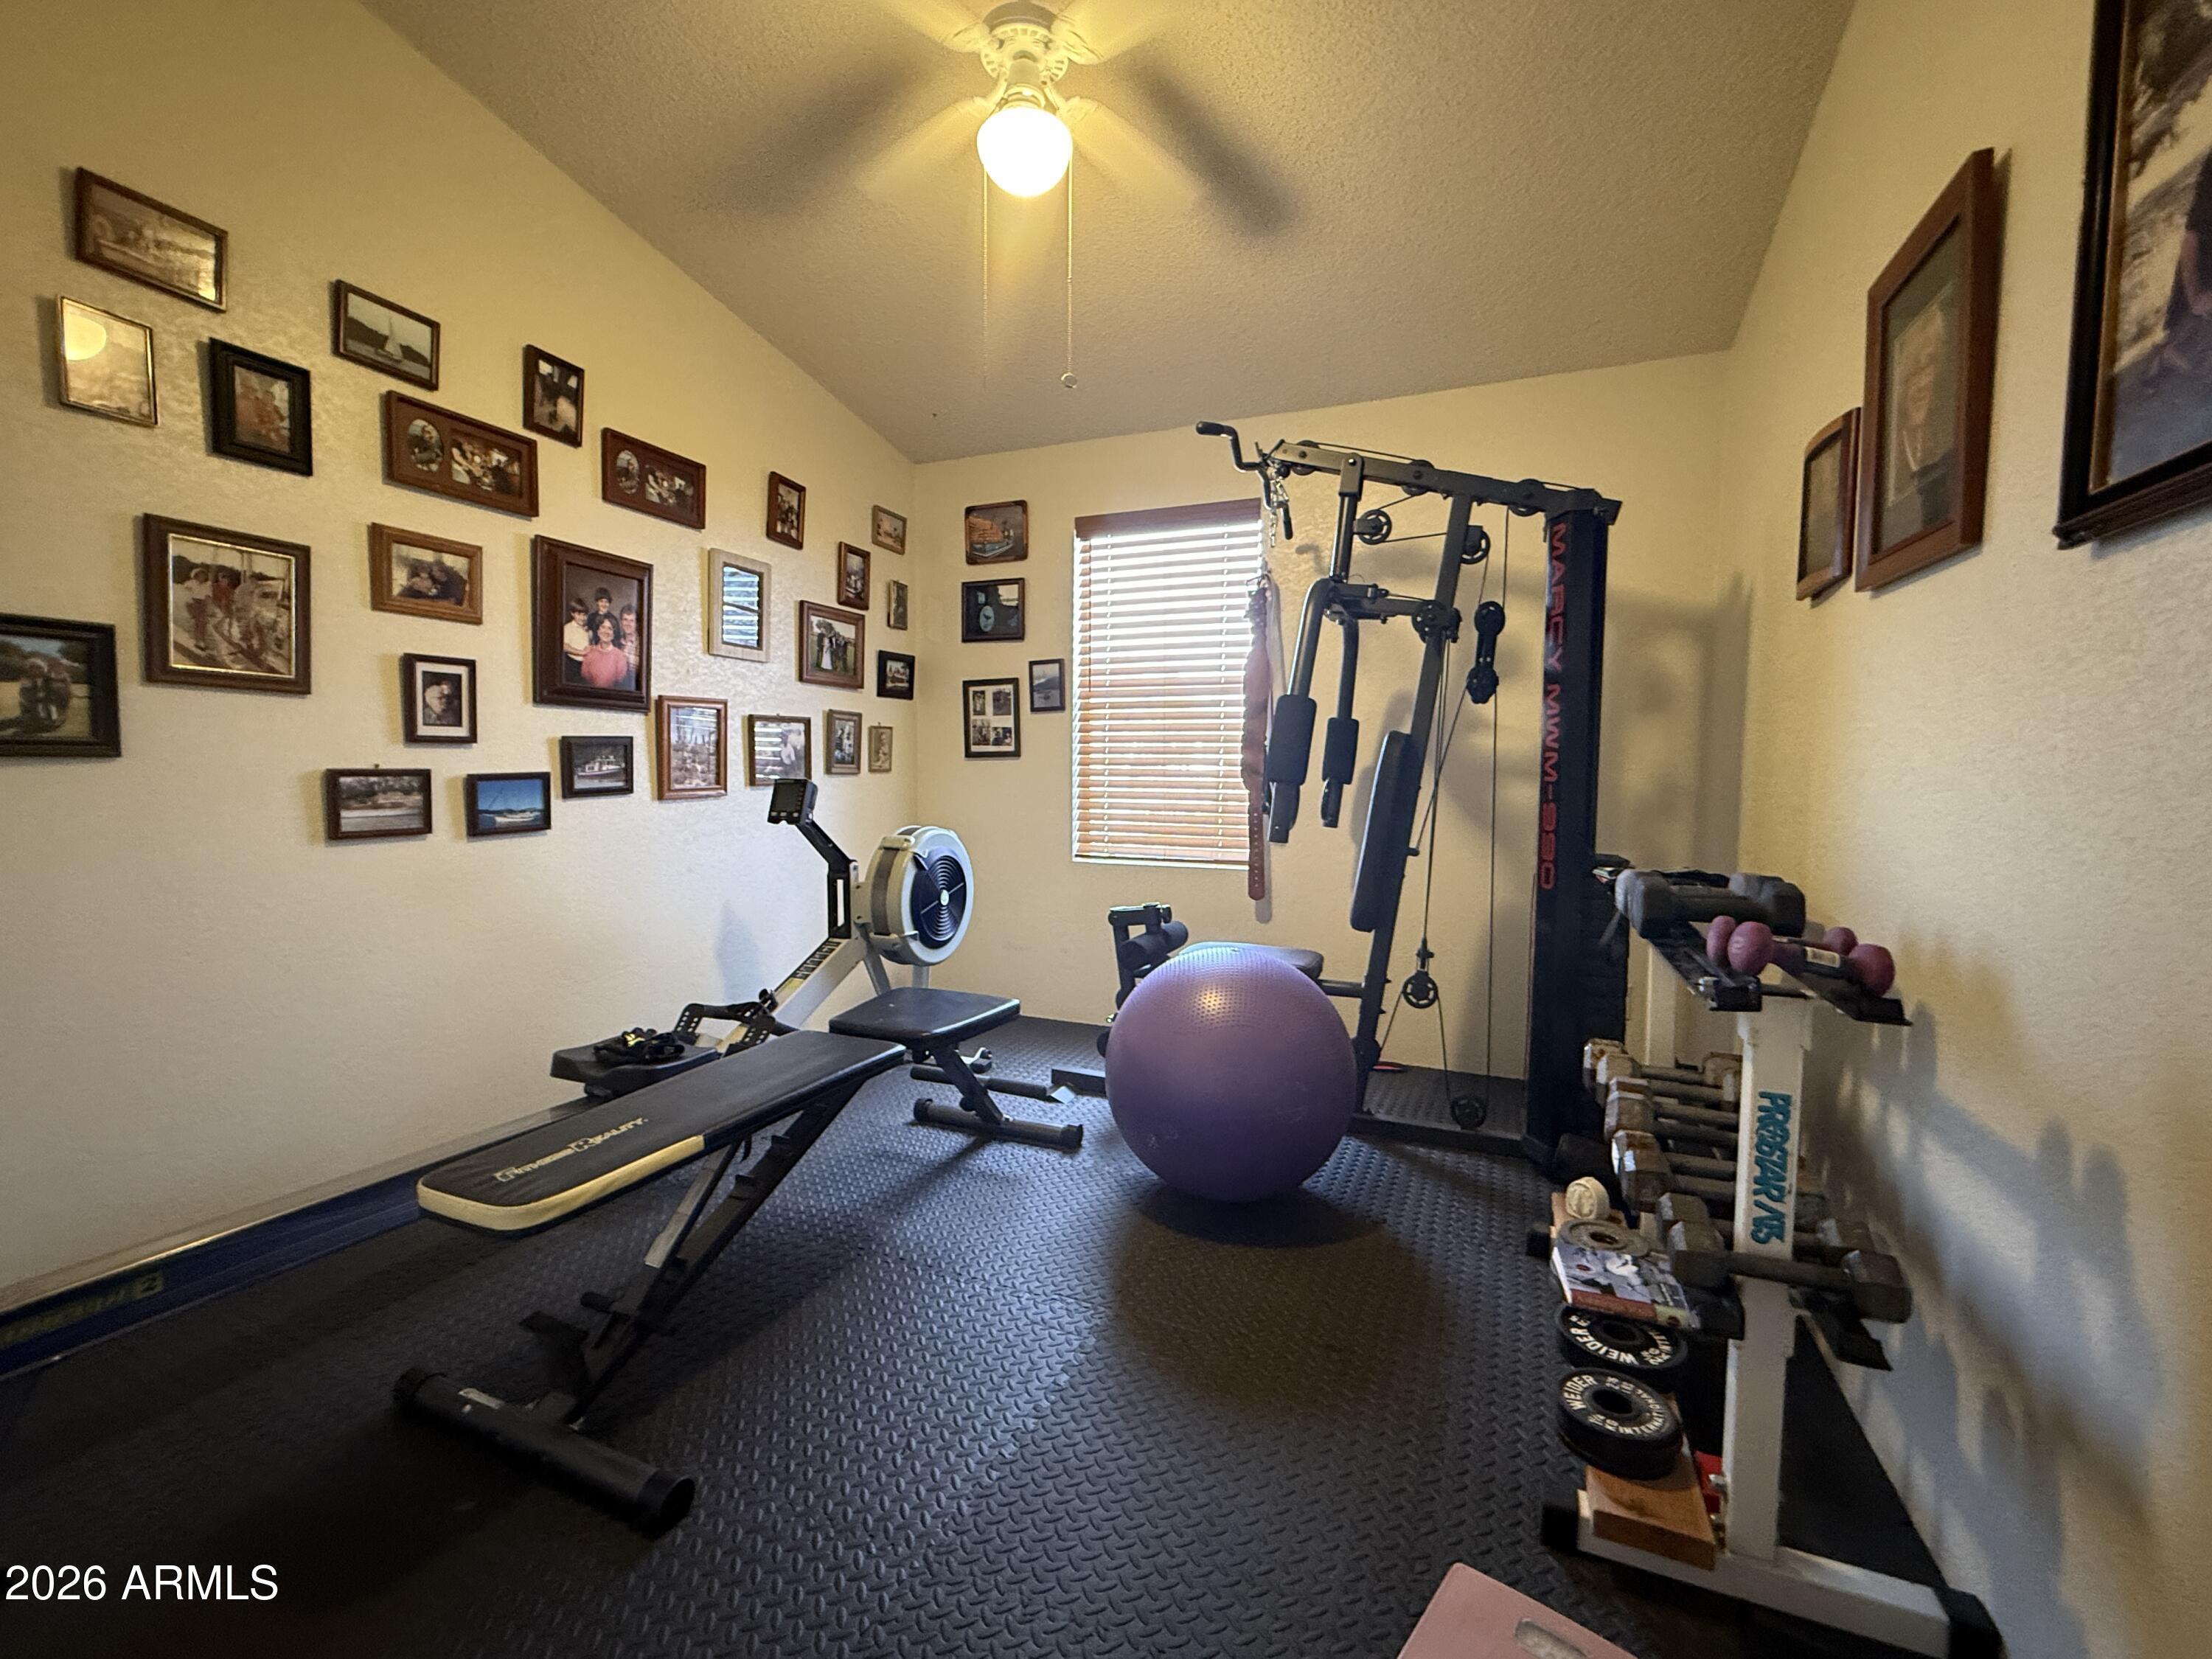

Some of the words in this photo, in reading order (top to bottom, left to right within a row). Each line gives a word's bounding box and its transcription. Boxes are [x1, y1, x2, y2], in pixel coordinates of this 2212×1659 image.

[1549, 522, 1567, 672] MARCY
[1753, 1091, 1792, 1203] PROSTAR
[1569, 1327, 1640, 1365] WEIDER
[1563, 1374, 1599, 1411] WEIDER
